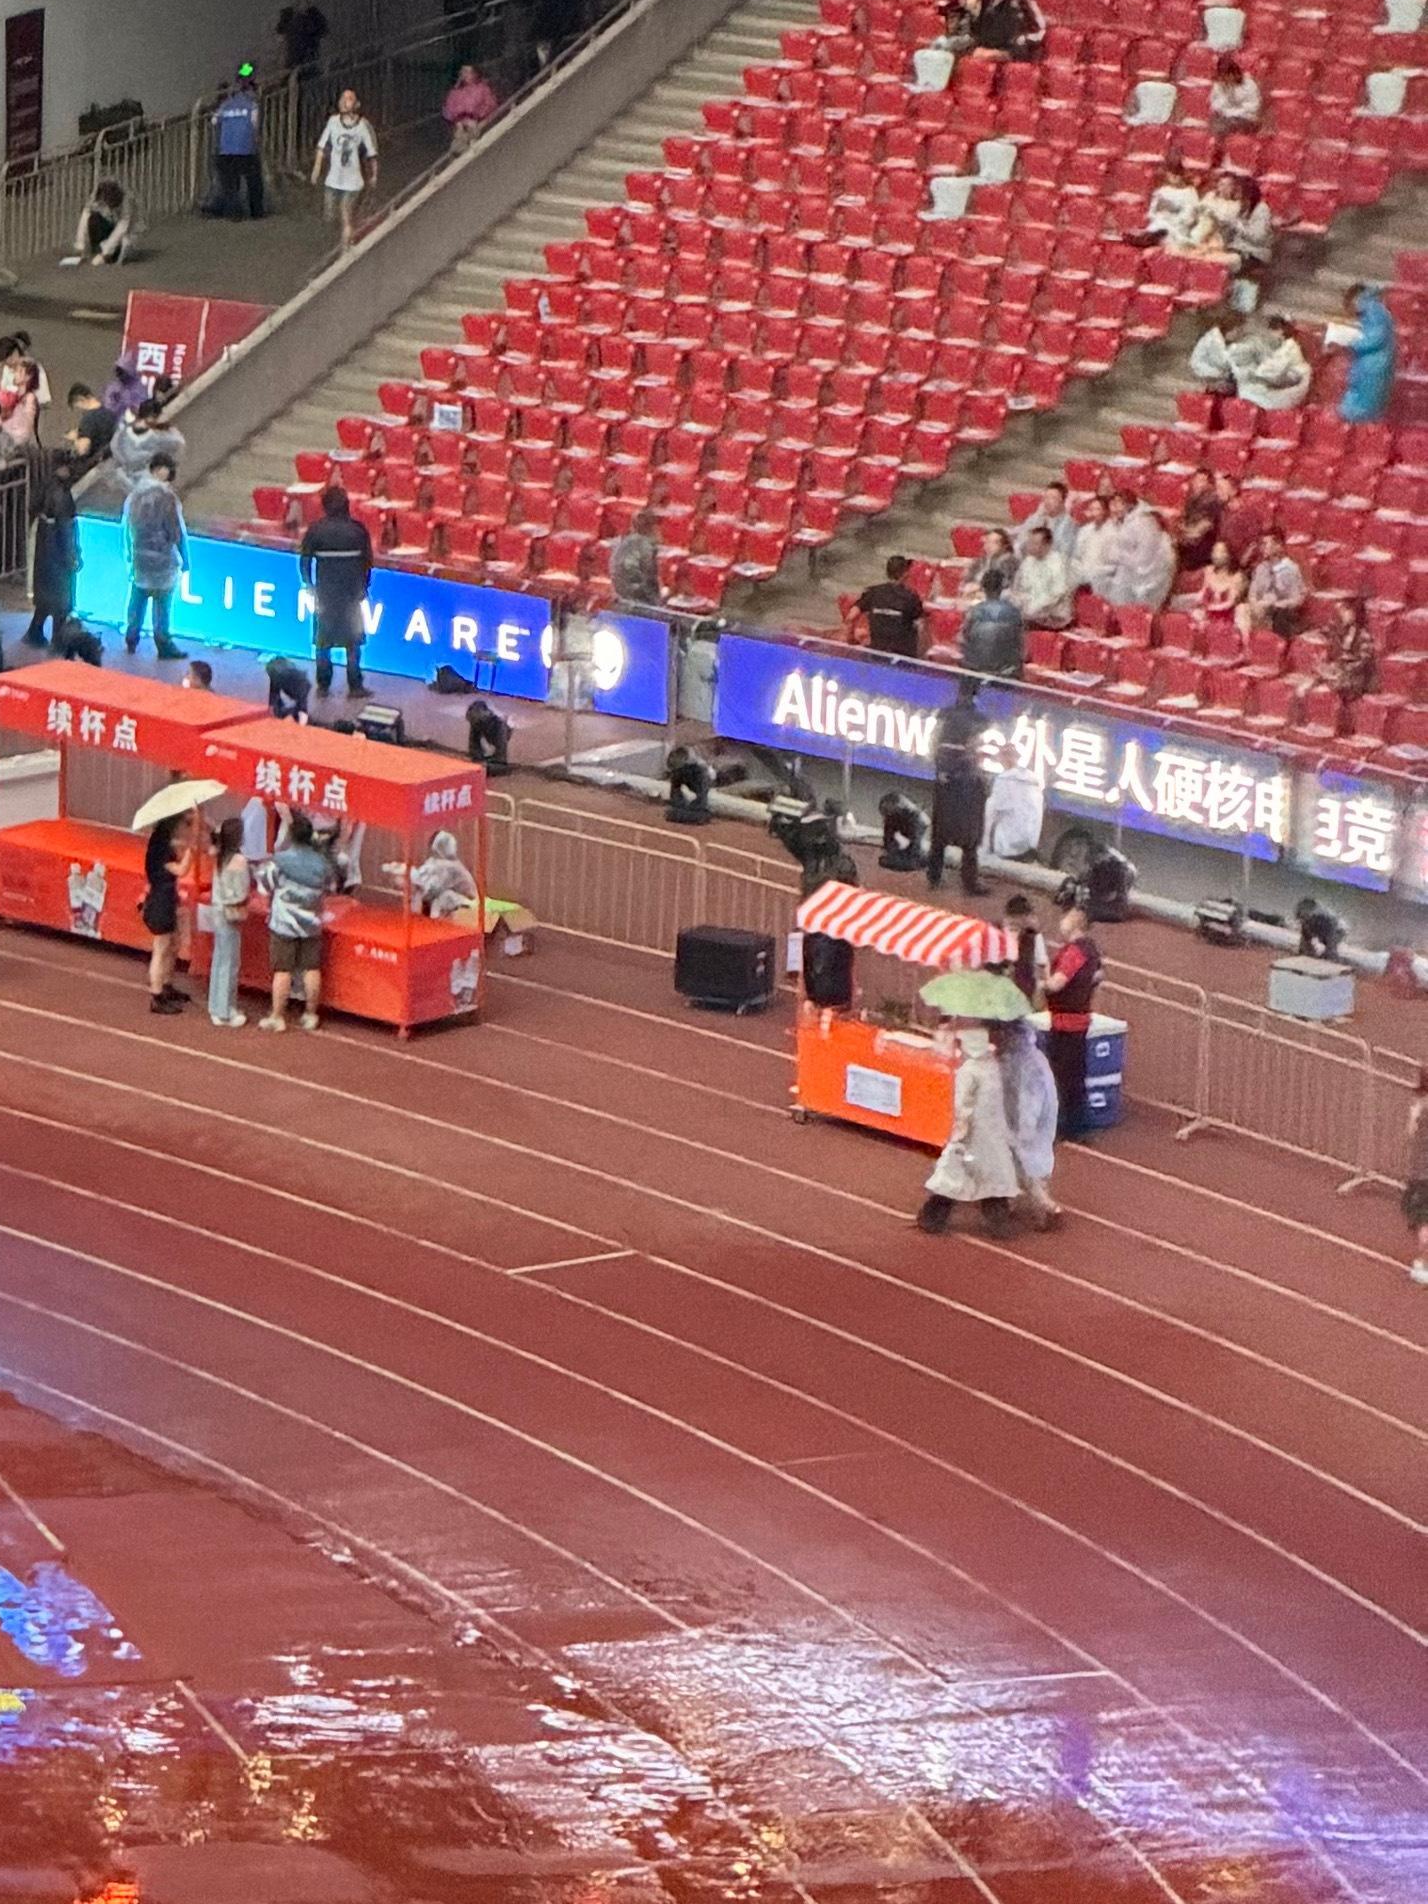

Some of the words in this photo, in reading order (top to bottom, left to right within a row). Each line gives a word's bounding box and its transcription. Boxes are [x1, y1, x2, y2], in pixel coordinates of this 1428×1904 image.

[47, 697, 138, 753] 续杯点
[254, 756, 348, 812] 续杯点
